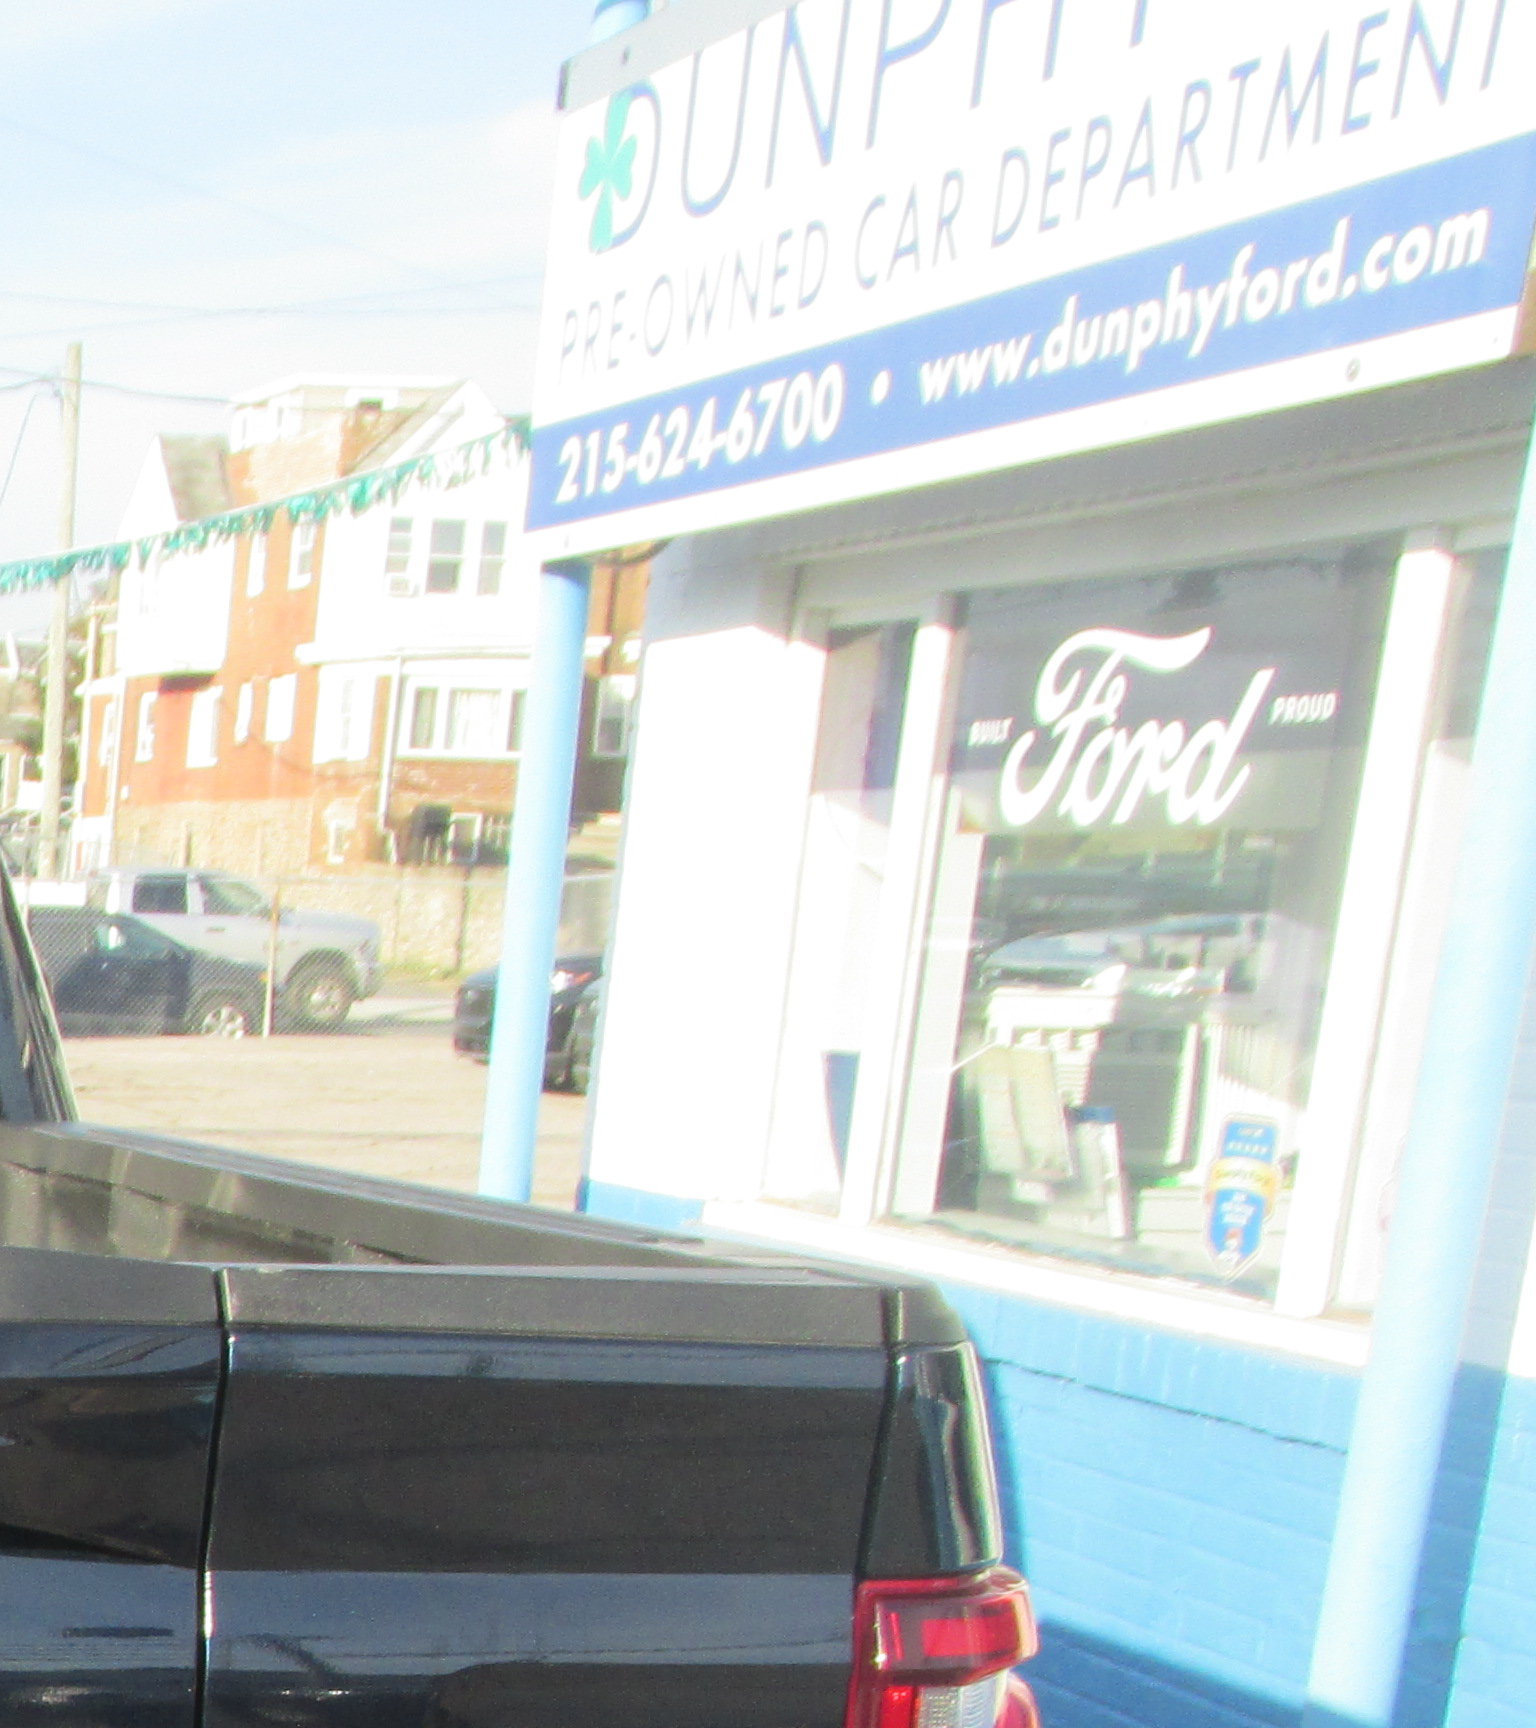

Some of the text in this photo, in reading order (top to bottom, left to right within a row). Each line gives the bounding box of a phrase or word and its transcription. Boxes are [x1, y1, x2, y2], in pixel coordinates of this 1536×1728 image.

[578, 0, 1150, 256] DUNPH
[555, 207, 1491, 504] 215-624-6700 www.dunphyford.com
[559, 219, 828, 386] PRE-OWNED
[855, 168, 964, 290] CAR
[1000, 626, 1276, 826] Ford
[1269, 692, 1337, 726] PROUD
